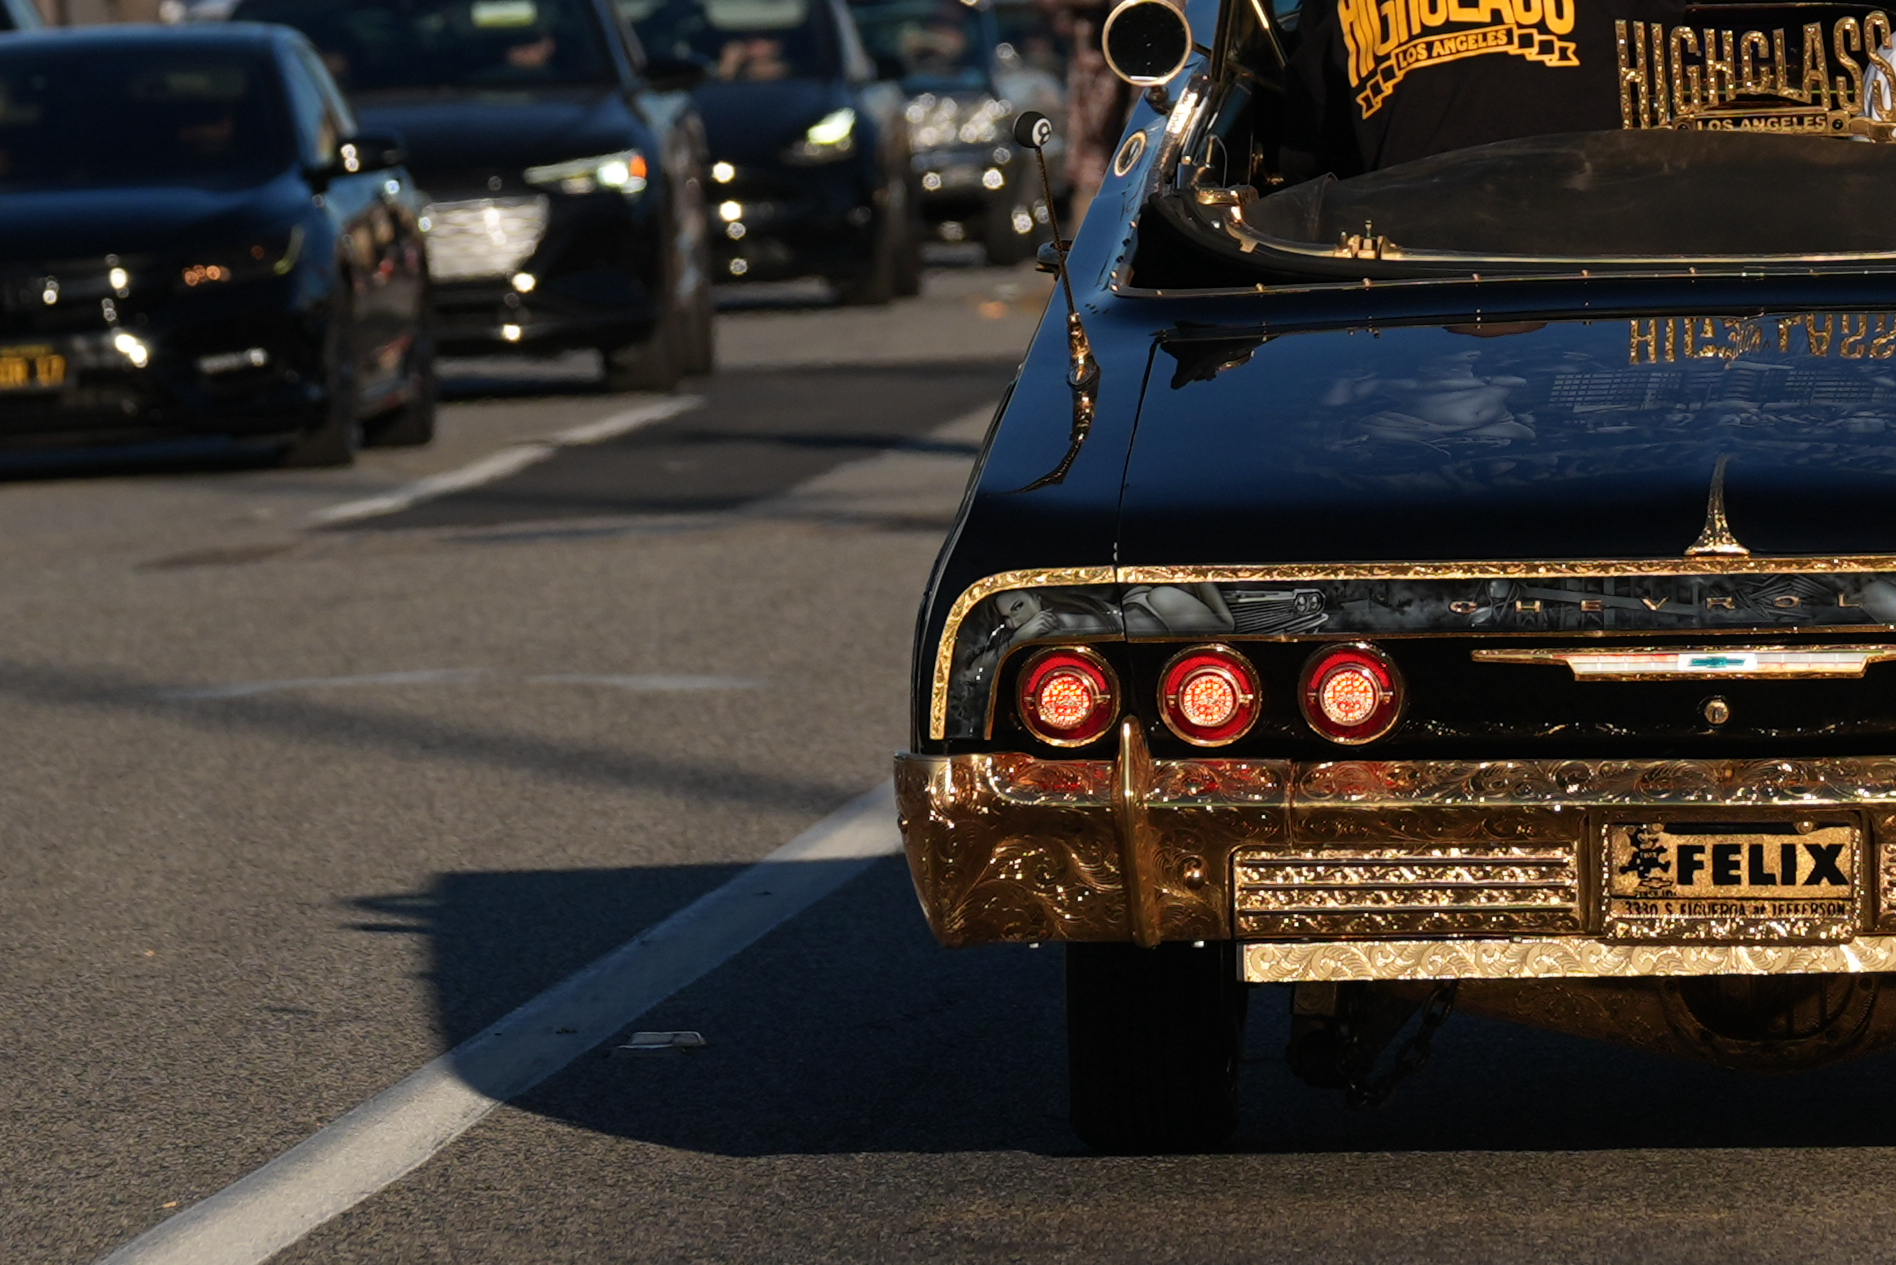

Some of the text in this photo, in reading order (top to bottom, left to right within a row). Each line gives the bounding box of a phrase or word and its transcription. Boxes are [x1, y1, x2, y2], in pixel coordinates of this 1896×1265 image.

[1399, 29, 1508, 70] LOS ANGELES
[1697, 115, 1828, 132] LOS ANGELES
[1677, 843, 1849, 886] FELIX
[1625, 900, 1659, 915] 3330
[1680, 901, 1746, 916] FIGUEROA
[1772, 901, 1845, 916] JEFFERSON
